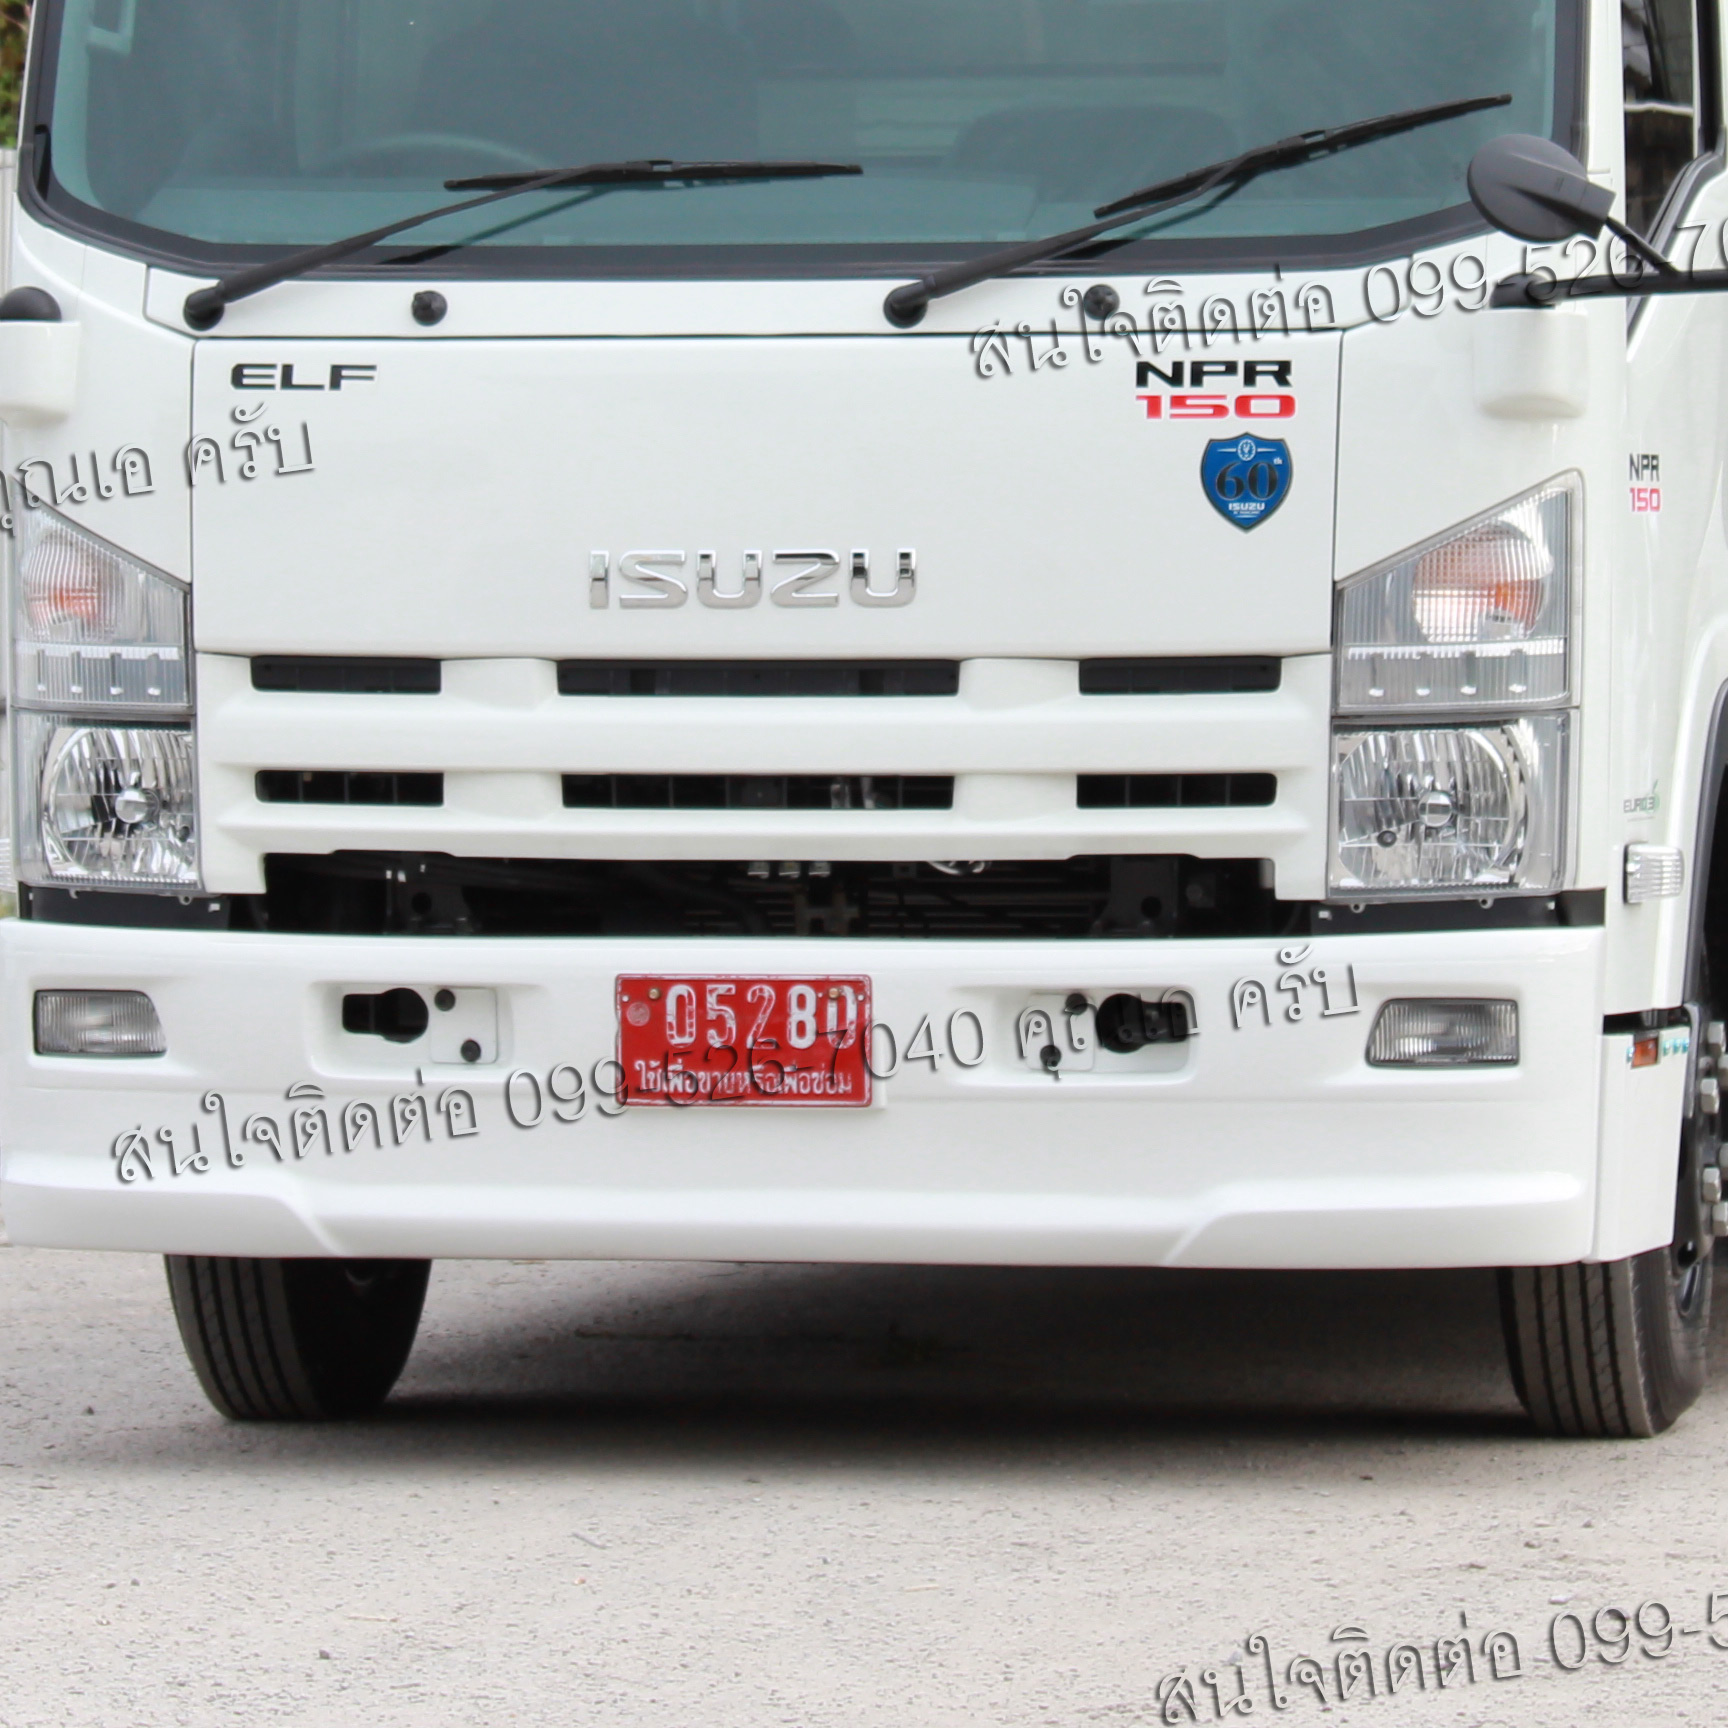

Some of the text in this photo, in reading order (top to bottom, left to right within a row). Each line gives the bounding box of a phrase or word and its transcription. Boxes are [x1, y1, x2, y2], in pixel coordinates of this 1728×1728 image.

[231, 363, 377, 390] ELF
[1136, 360, 1293, 388] NPR
[1136, 394, 1296, 419] 150
[1629, 453, 1660, 482] NPR
[1228, 502, 1266, 511] ISUZU
[1629, 487, 1661, 512] 150
[589, 548, 918, 608] ISUZU
